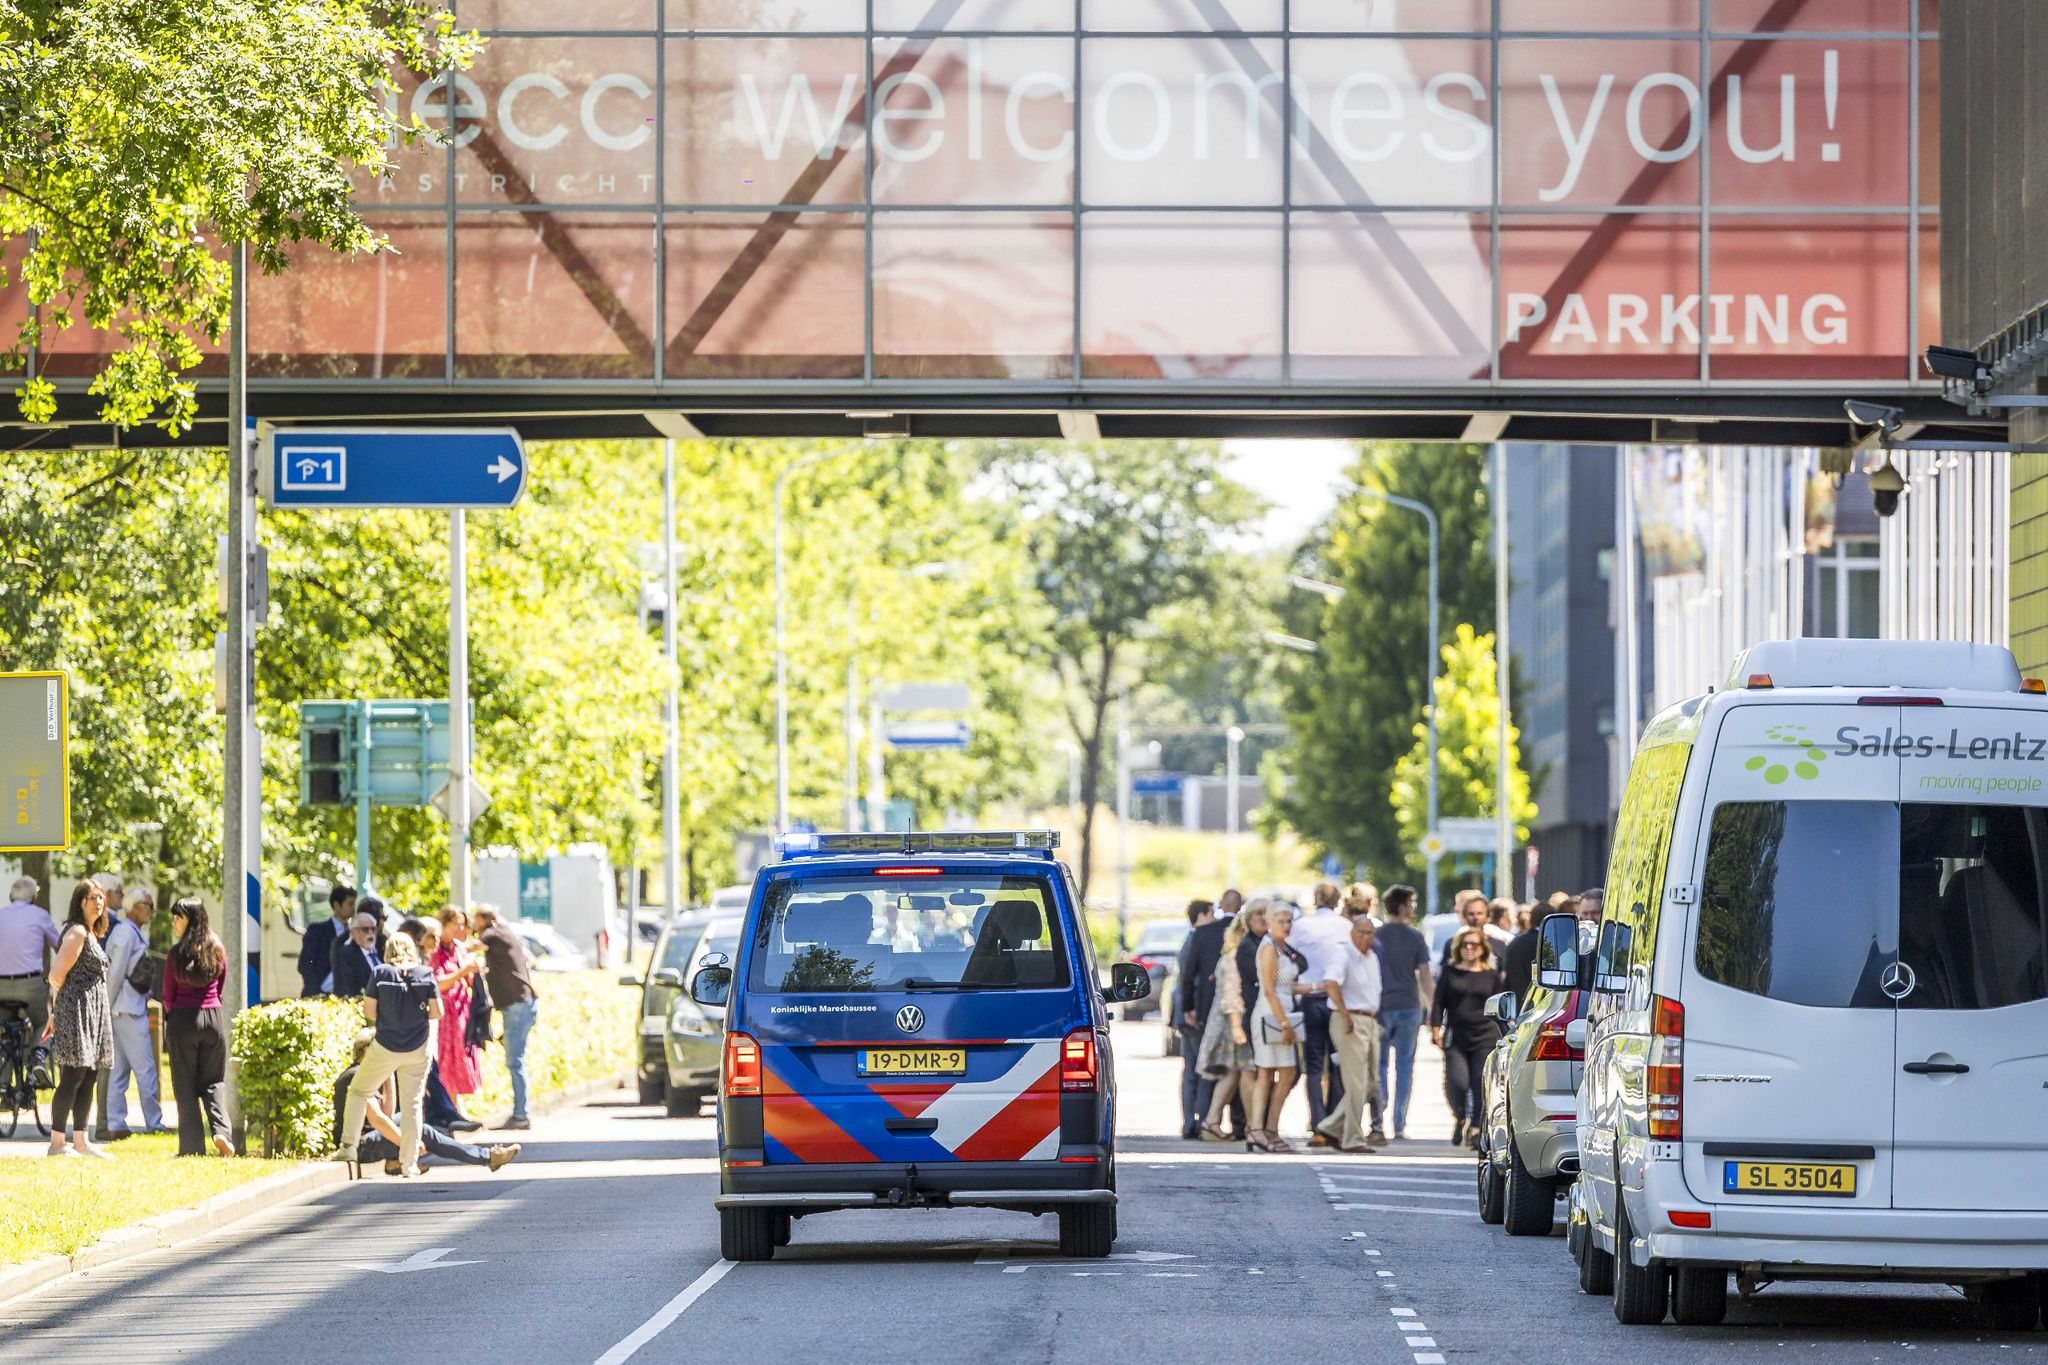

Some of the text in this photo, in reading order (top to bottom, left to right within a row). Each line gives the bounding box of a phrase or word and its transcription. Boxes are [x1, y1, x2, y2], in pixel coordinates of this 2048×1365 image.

[739, 38, 1491, 162] welcomes
[1538, 49, 1841, 202] you!
[340, 174, 653, 194] ASTRICHT
[1505, 292, 1848, 345] PARKING
[1834, 725, 2047, 761] Sales-Lentz
[1919, 773, 2042, 795] moving people
[770, 1004, 877, 1014] Koninklijke Marechaussee
[872, 1052, 960, 1069] 19-DMR-9
[1728, 1166, 1843, 1189] L SL 3504
